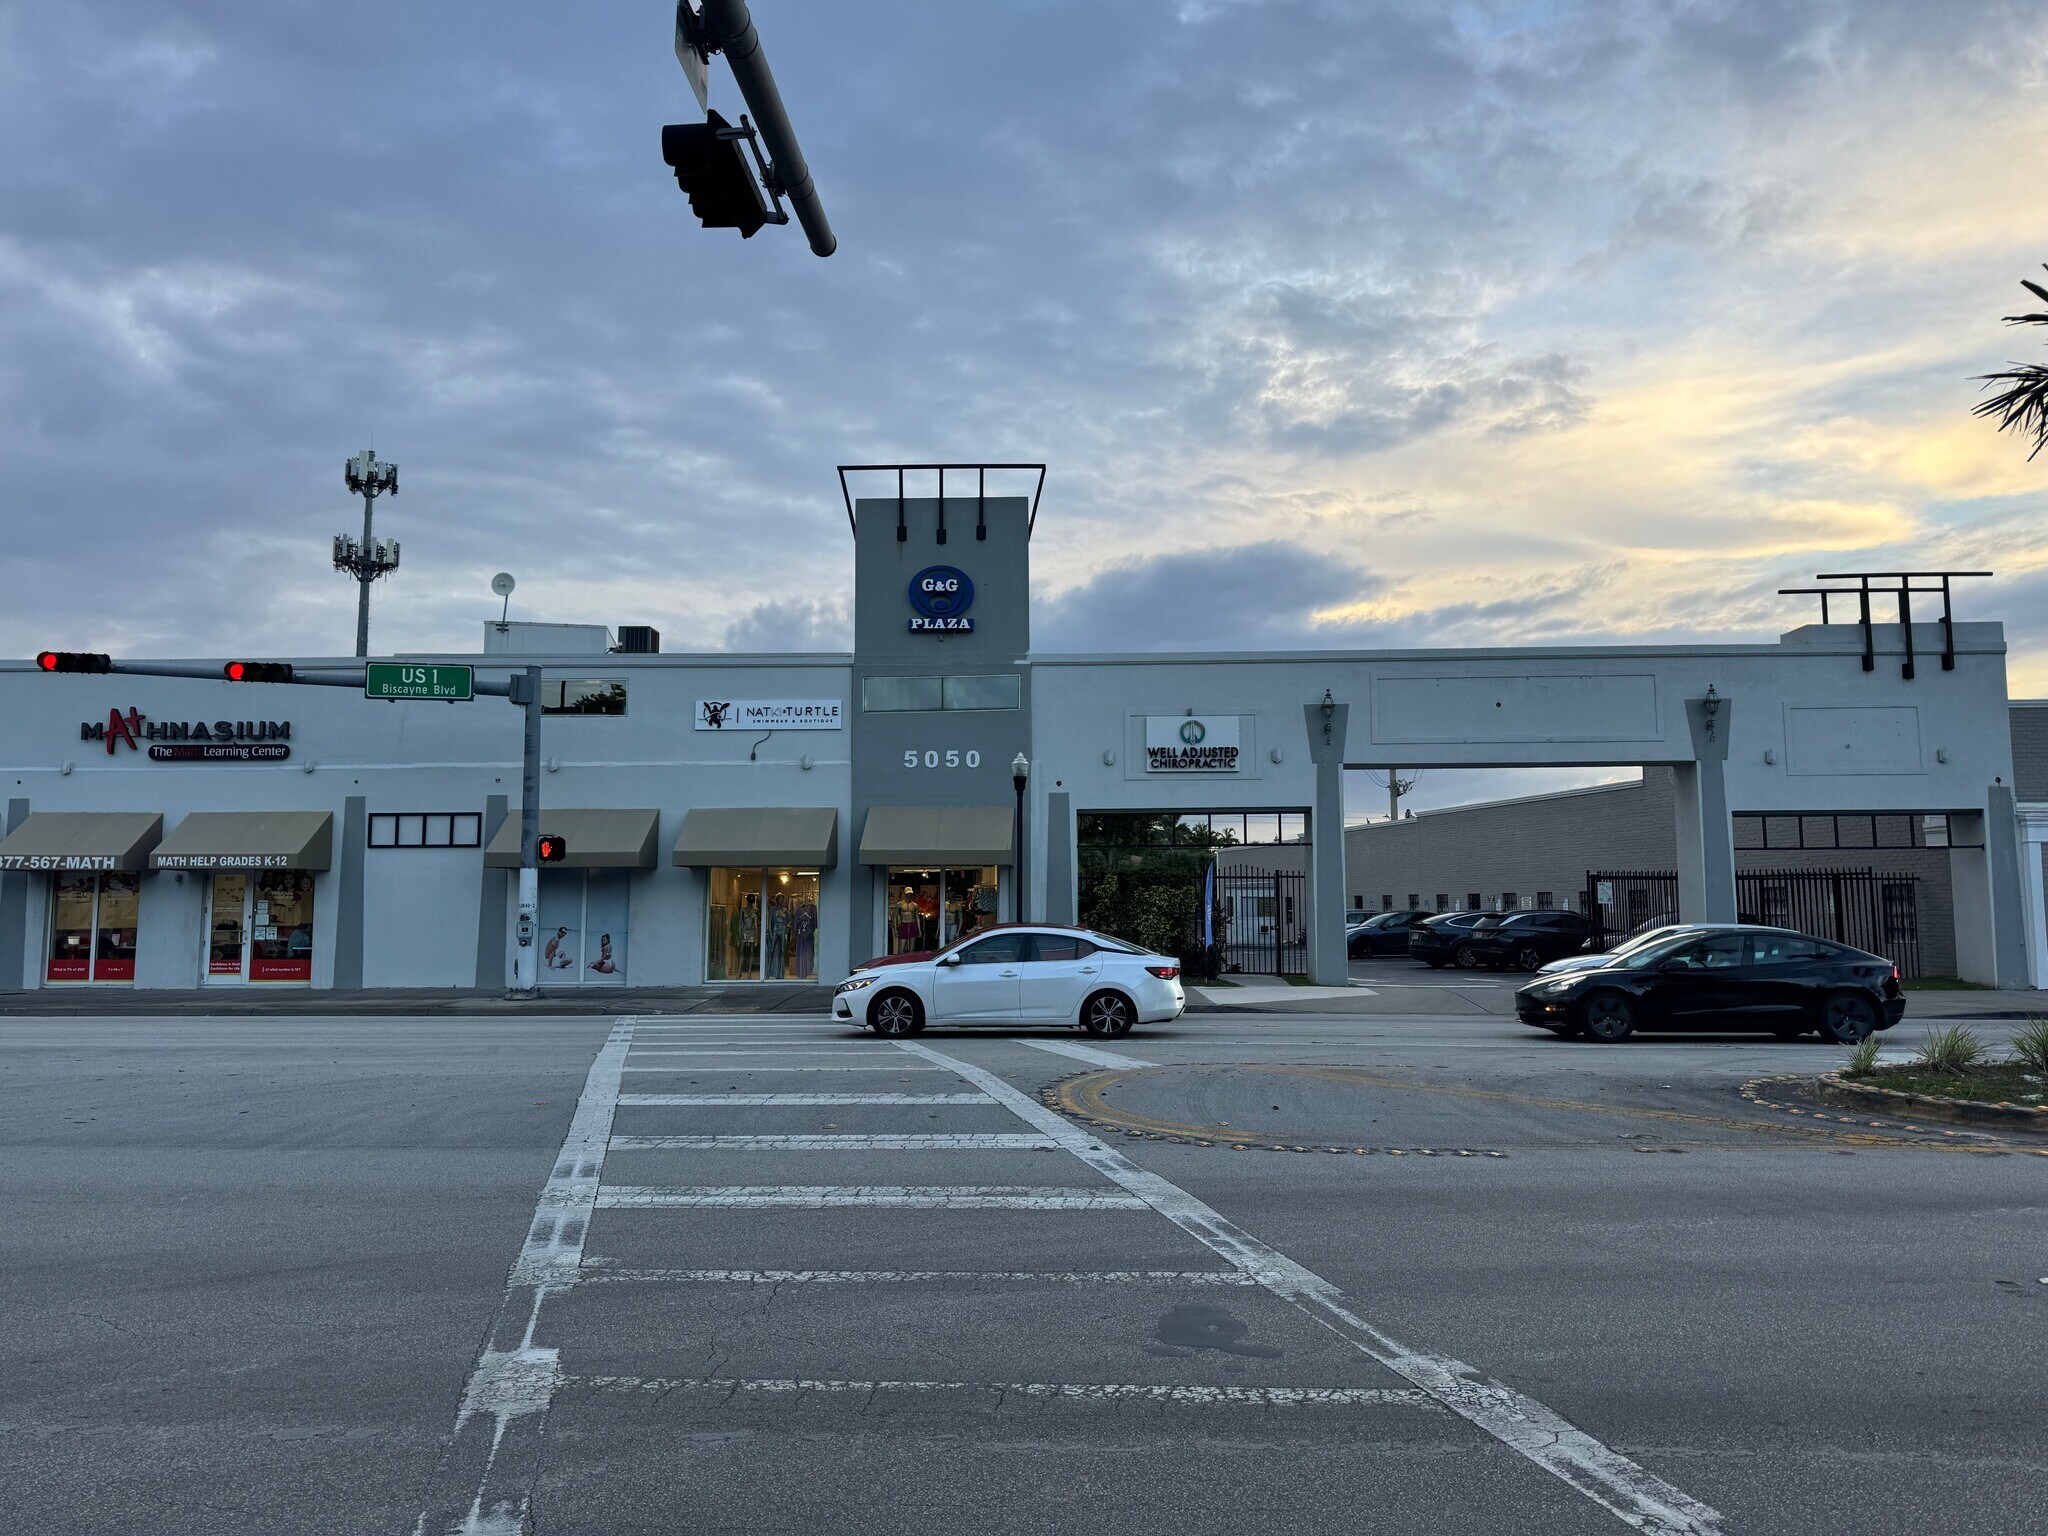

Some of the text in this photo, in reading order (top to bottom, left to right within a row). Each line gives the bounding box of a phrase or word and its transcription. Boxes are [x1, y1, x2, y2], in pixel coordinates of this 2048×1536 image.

[922, 578, 959, 592] G&G
[911, 618, 971, 629] PLAZA
[402, 668, 438, 684] US 1
[382, 683, 456, 695] Biscayne Blvd
[786, 706, 839, 717] TURTLE
[153, 746, 173, 757] The
[204, 746, 249, 759] Learning
[251, 746, 286, 757] Center
[1147, 746, 1239, 759] WELL ADJUSTED
[903, 750, 981, 768] 5050
[1150, 758, 1236, 769] CHIROPRACTIC
[157, 856, 288, 867] MATH HELP GRADES K-12
